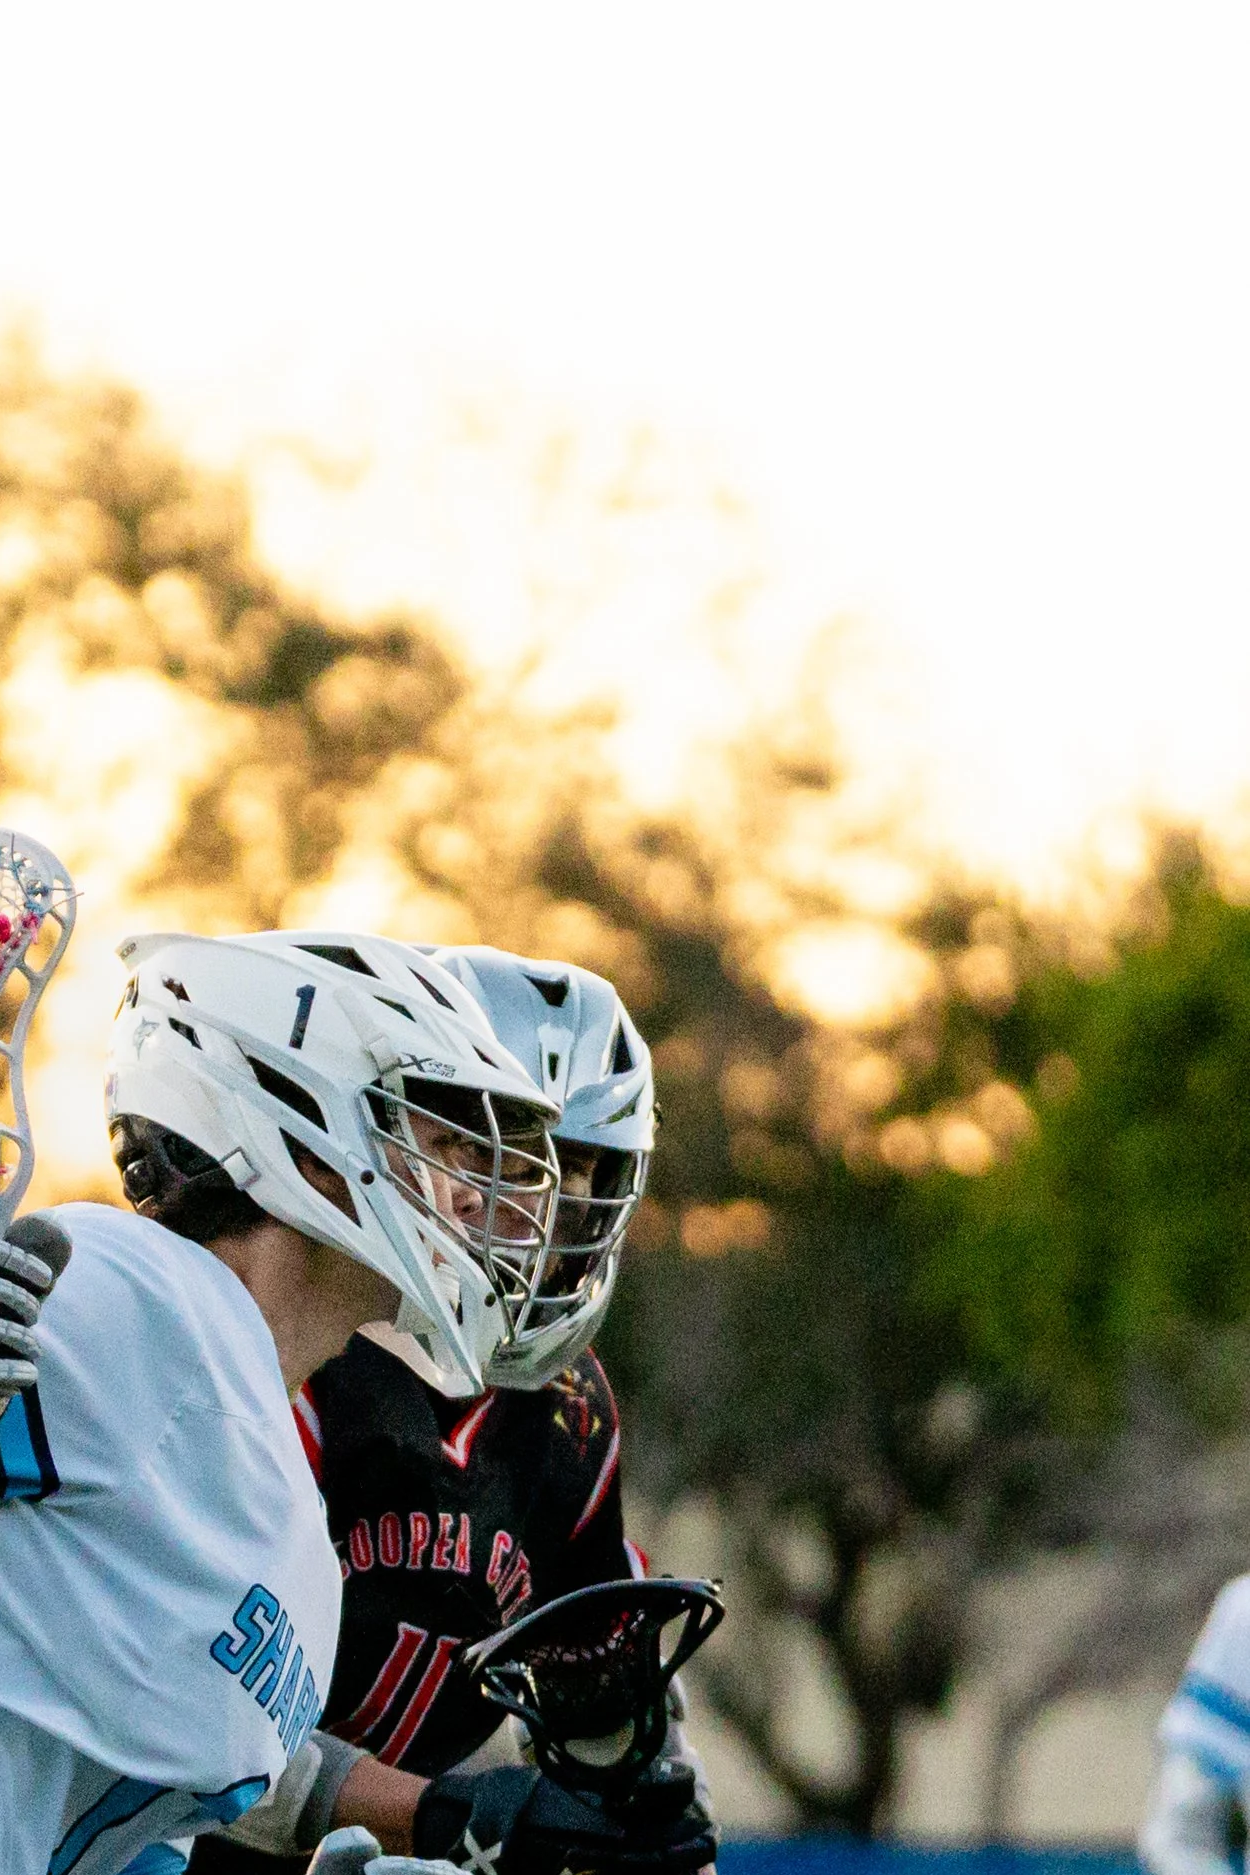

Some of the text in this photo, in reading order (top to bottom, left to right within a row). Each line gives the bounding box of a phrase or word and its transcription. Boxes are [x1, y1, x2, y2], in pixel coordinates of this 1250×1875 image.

[289, 984, 317, 1050] 1
[336, 1511, 471, 1581] OOPER
[327, 1621, 463, 1768] 11
